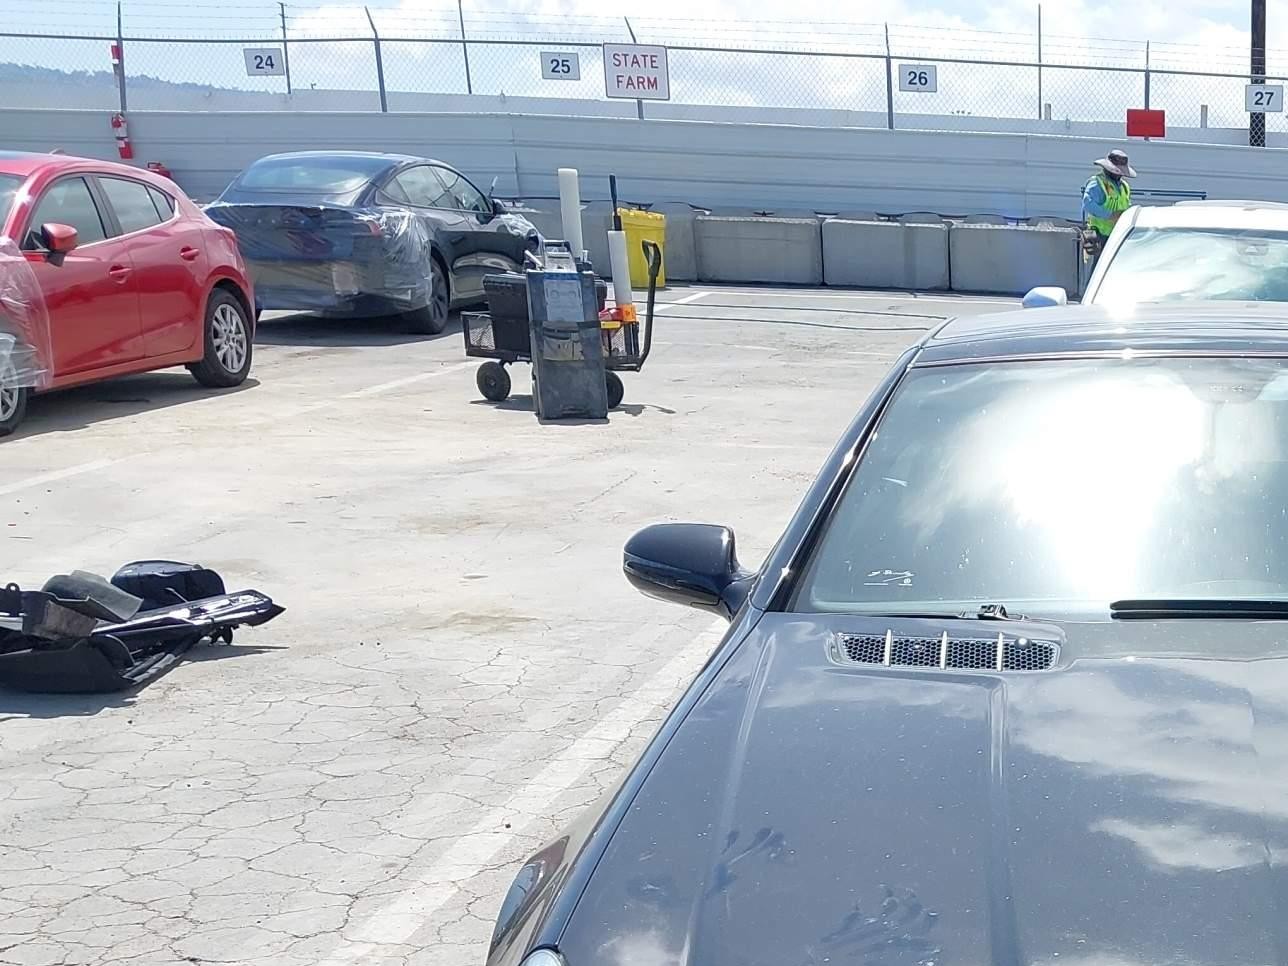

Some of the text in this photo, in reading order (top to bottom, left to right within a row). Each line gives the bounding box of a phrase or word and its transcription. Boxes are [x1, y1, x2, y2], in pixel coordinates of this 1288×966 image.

[254, 55, 275, 70] 24
[551, 59, 571, 74] 25
[613, 53, 659, 69] STATE
[616, 75, 658, 90] FARM
[908, 71, 928, 86] 26
[1254, 91, 1274, 106] 27
